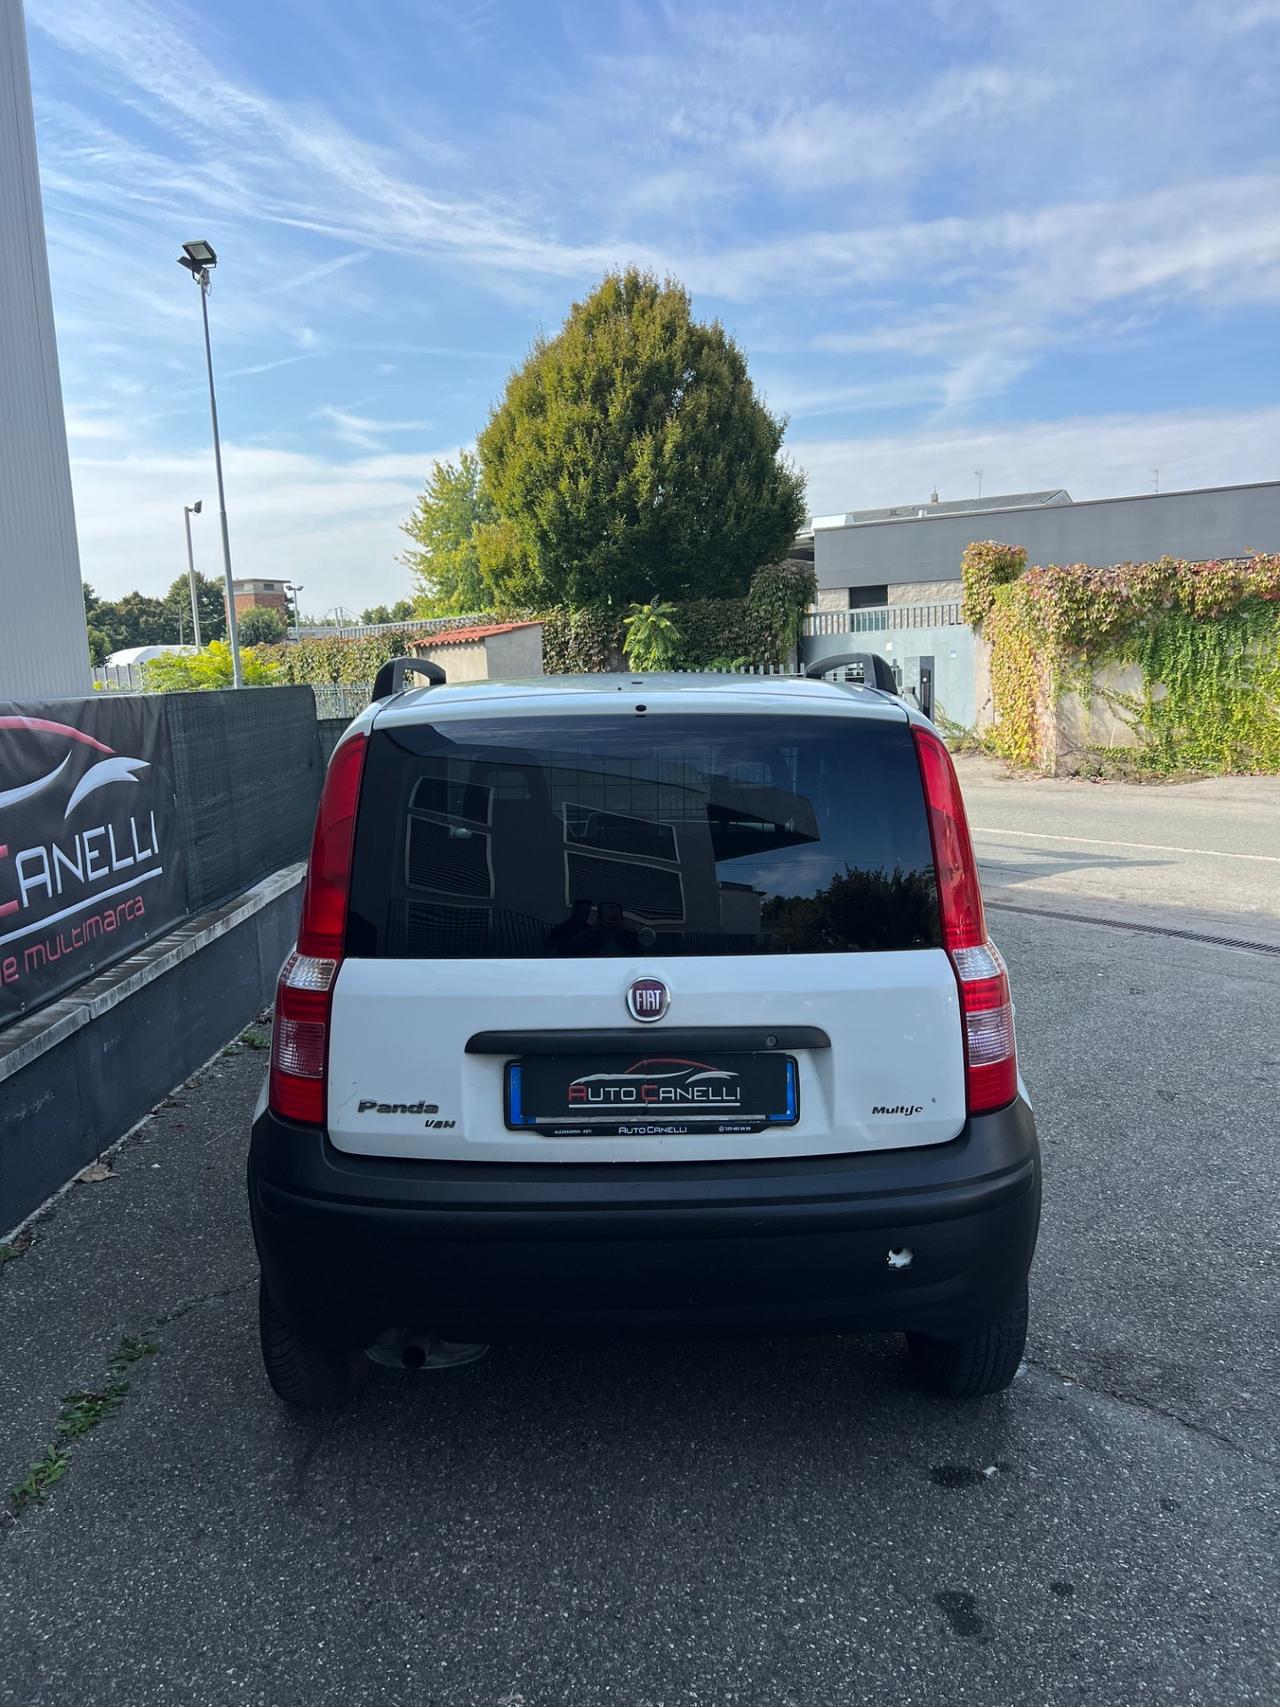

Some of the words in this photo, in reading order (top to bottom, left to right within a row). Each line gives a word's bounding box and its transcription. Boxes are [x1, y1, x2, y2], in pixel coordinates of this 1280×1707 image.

[23, 895, 146, 974] multimarca
[635, 989, 662, 1010] FIAT
[357, 1099, 440, 1115] Panda
